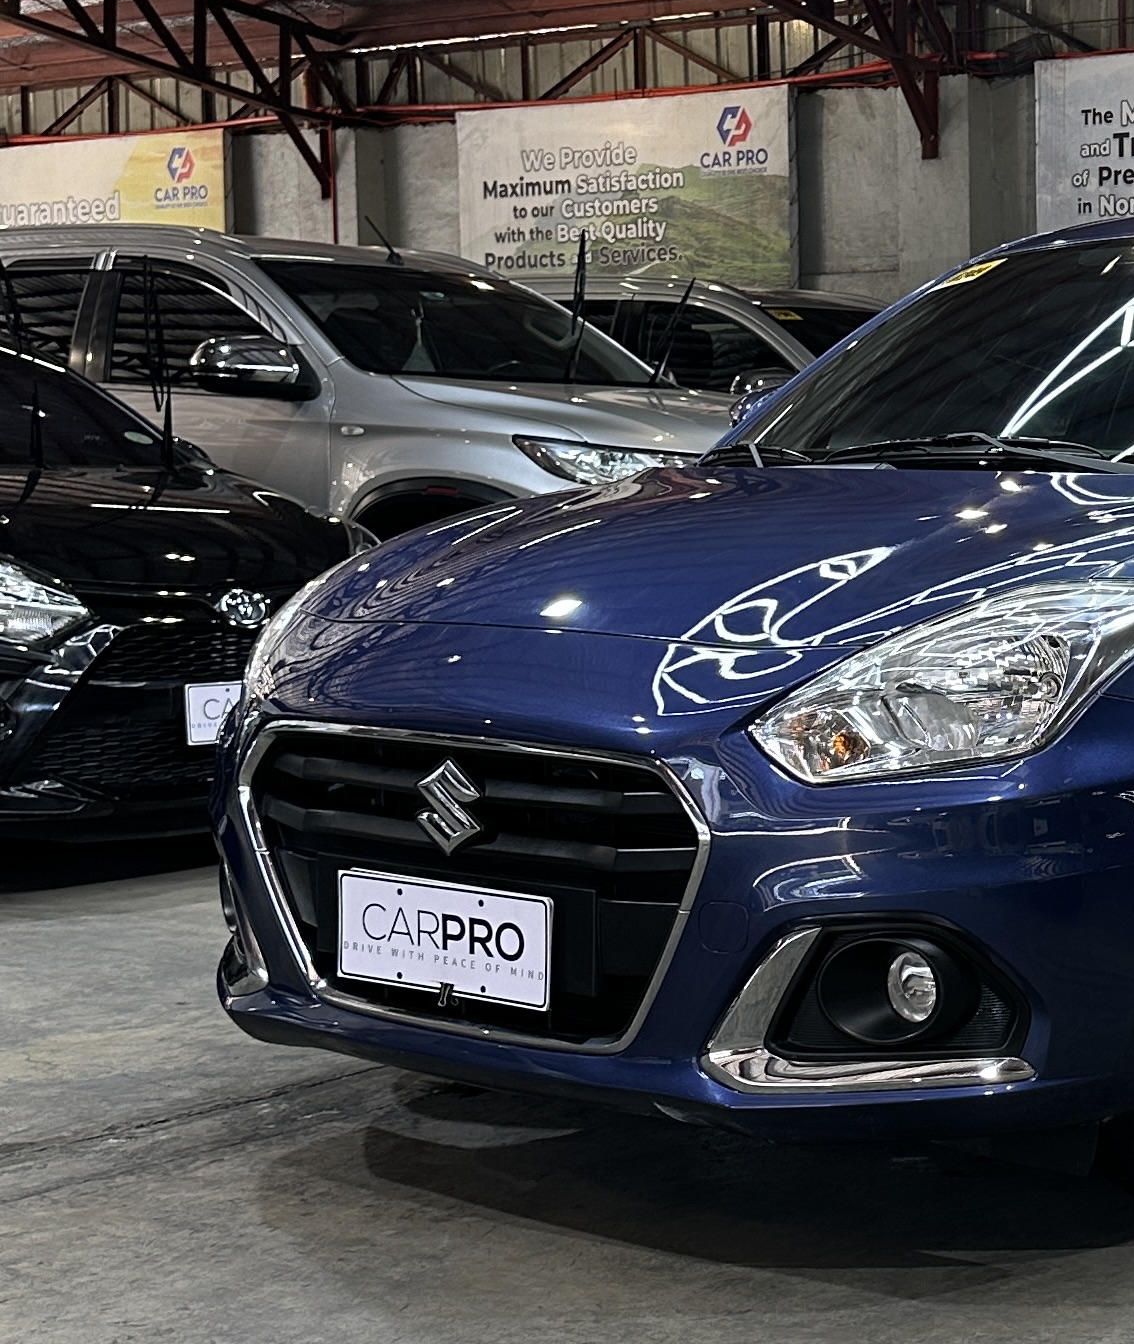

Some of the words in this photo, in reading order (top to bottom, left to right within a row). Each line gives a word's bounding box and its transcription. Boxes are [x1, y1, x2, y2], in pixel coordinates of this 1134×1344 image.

[1081, 107, 1114, 126] The
[521, 150, 555, 173] We
[559, 142, 637, 171] Provide
[700, 151, 732, 169] CAR
[736, 147, 768, 167] PRO
[1080, 138, 1111, 157] and
[483, 177, 571, 200] Maximum
[576, 168, 685, 195] Satisfaction
[1072, 169, 1090, 187] of
[154, 187, 180, 202] CAR
[183, 184, 208, 200] PRO
[0, 189, 121, 226] uaranteed
[513, 206, 527, 220] to
[532, 206, 555, 219] our
[561, 196, 659, 219] Customers
[1078, 198, 1092, 215] in
[495, 227, 526, 244] with
[530, 227, 552, 242] the
[557, 222, 596, 243] Best
[601, 218, 667, 243] Quality
[484, 249, 567, 270] Products
[571, 250, 593, 265] ad
[599, 242, 683, 267] Services.
[362, 903, 525, 962] CARPRO
[343, 940, 382, 955] DRIVE
[391, 947, 424, 962] WITH
[433, 954, 476, 970] PEACE
[485, 962, 501, 974] OF
[510, 966, 544, 981] MIND
